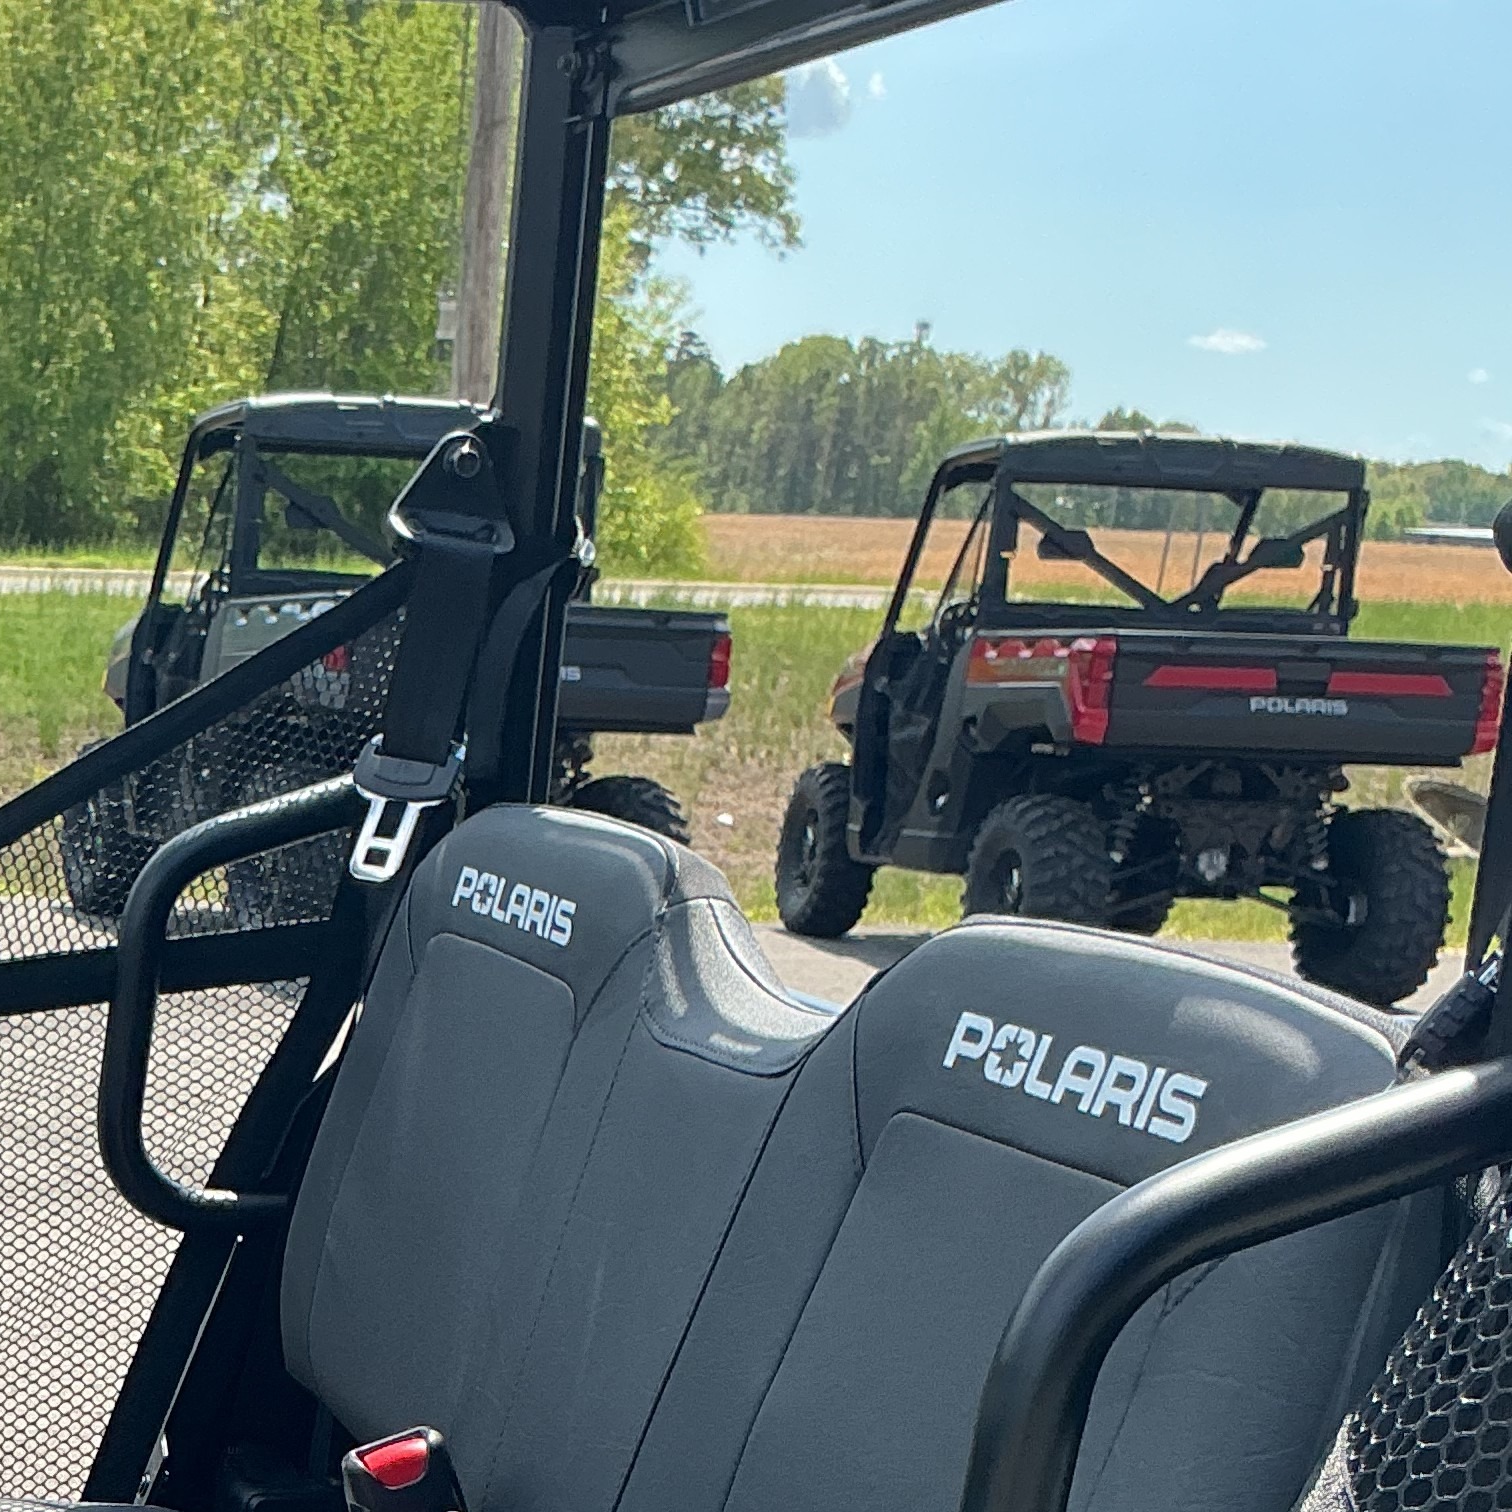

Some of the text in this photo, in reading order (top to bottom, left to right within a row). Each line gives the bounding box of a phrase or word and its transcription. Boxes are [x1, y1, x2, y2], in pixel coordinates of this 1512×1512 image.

[1249, 696, 1348, 716] POLARIS
[451, 865, 578, 947] POLARIS
[942, 1011, 1209, 1144] POLARIS
